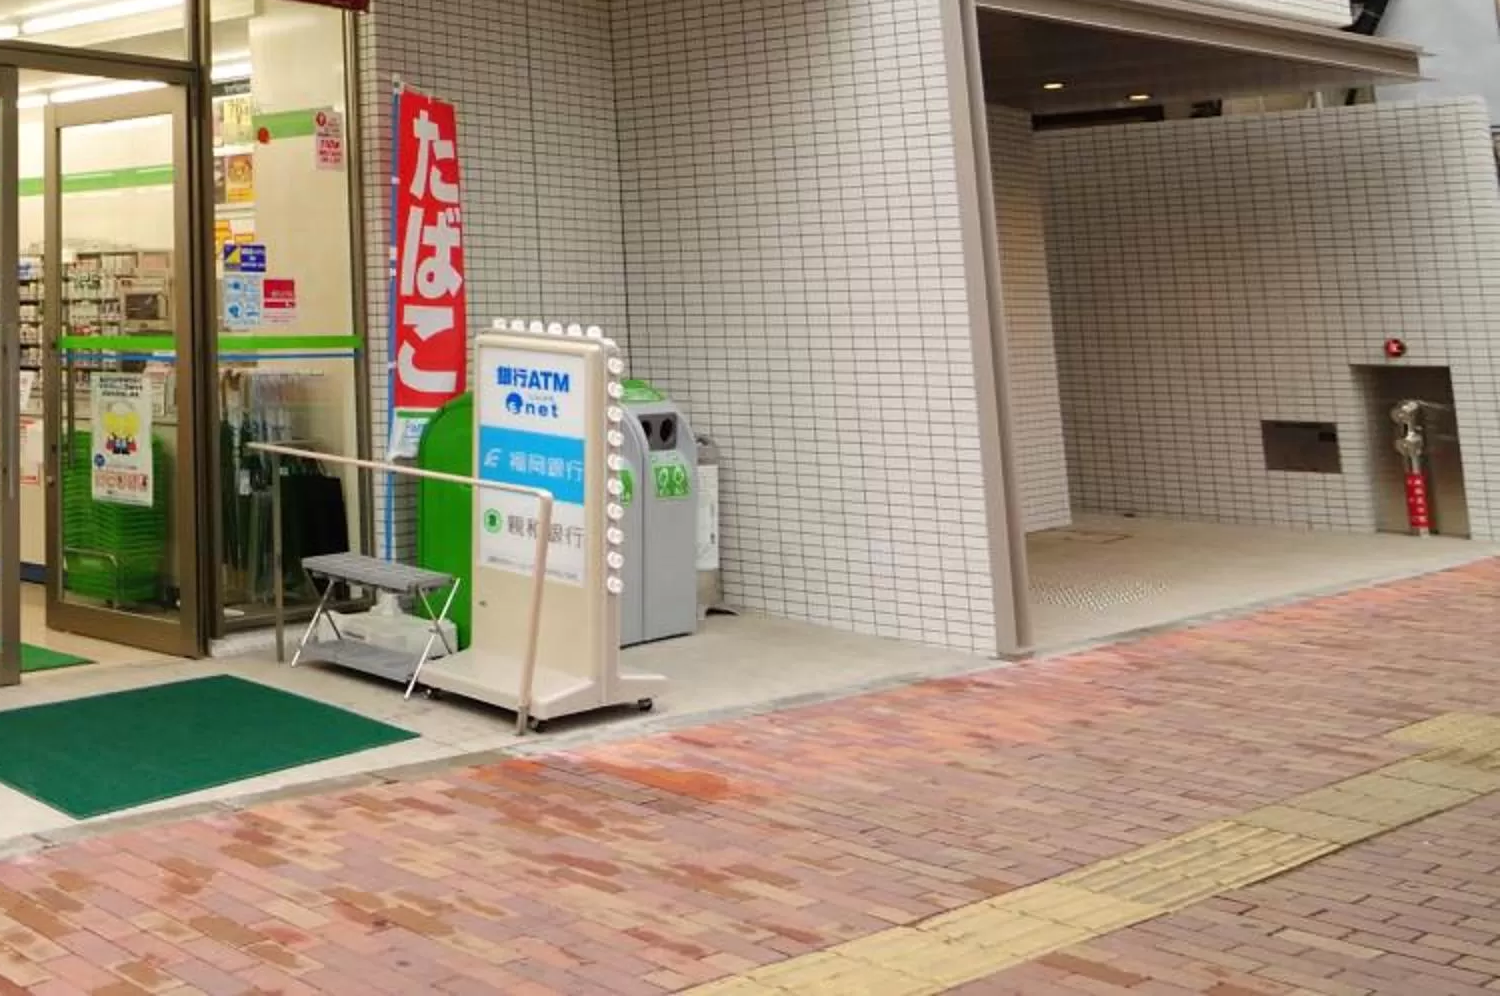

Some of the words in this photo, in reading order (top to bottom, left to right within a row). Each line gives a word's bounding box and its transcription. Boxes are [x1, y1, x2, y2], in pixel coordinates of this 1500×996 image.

[397, 109, 463, 393] たばこ
[497, 365, 570, 393] 銀行ATM
[509, 450, 584, 482] 福岡銀行
